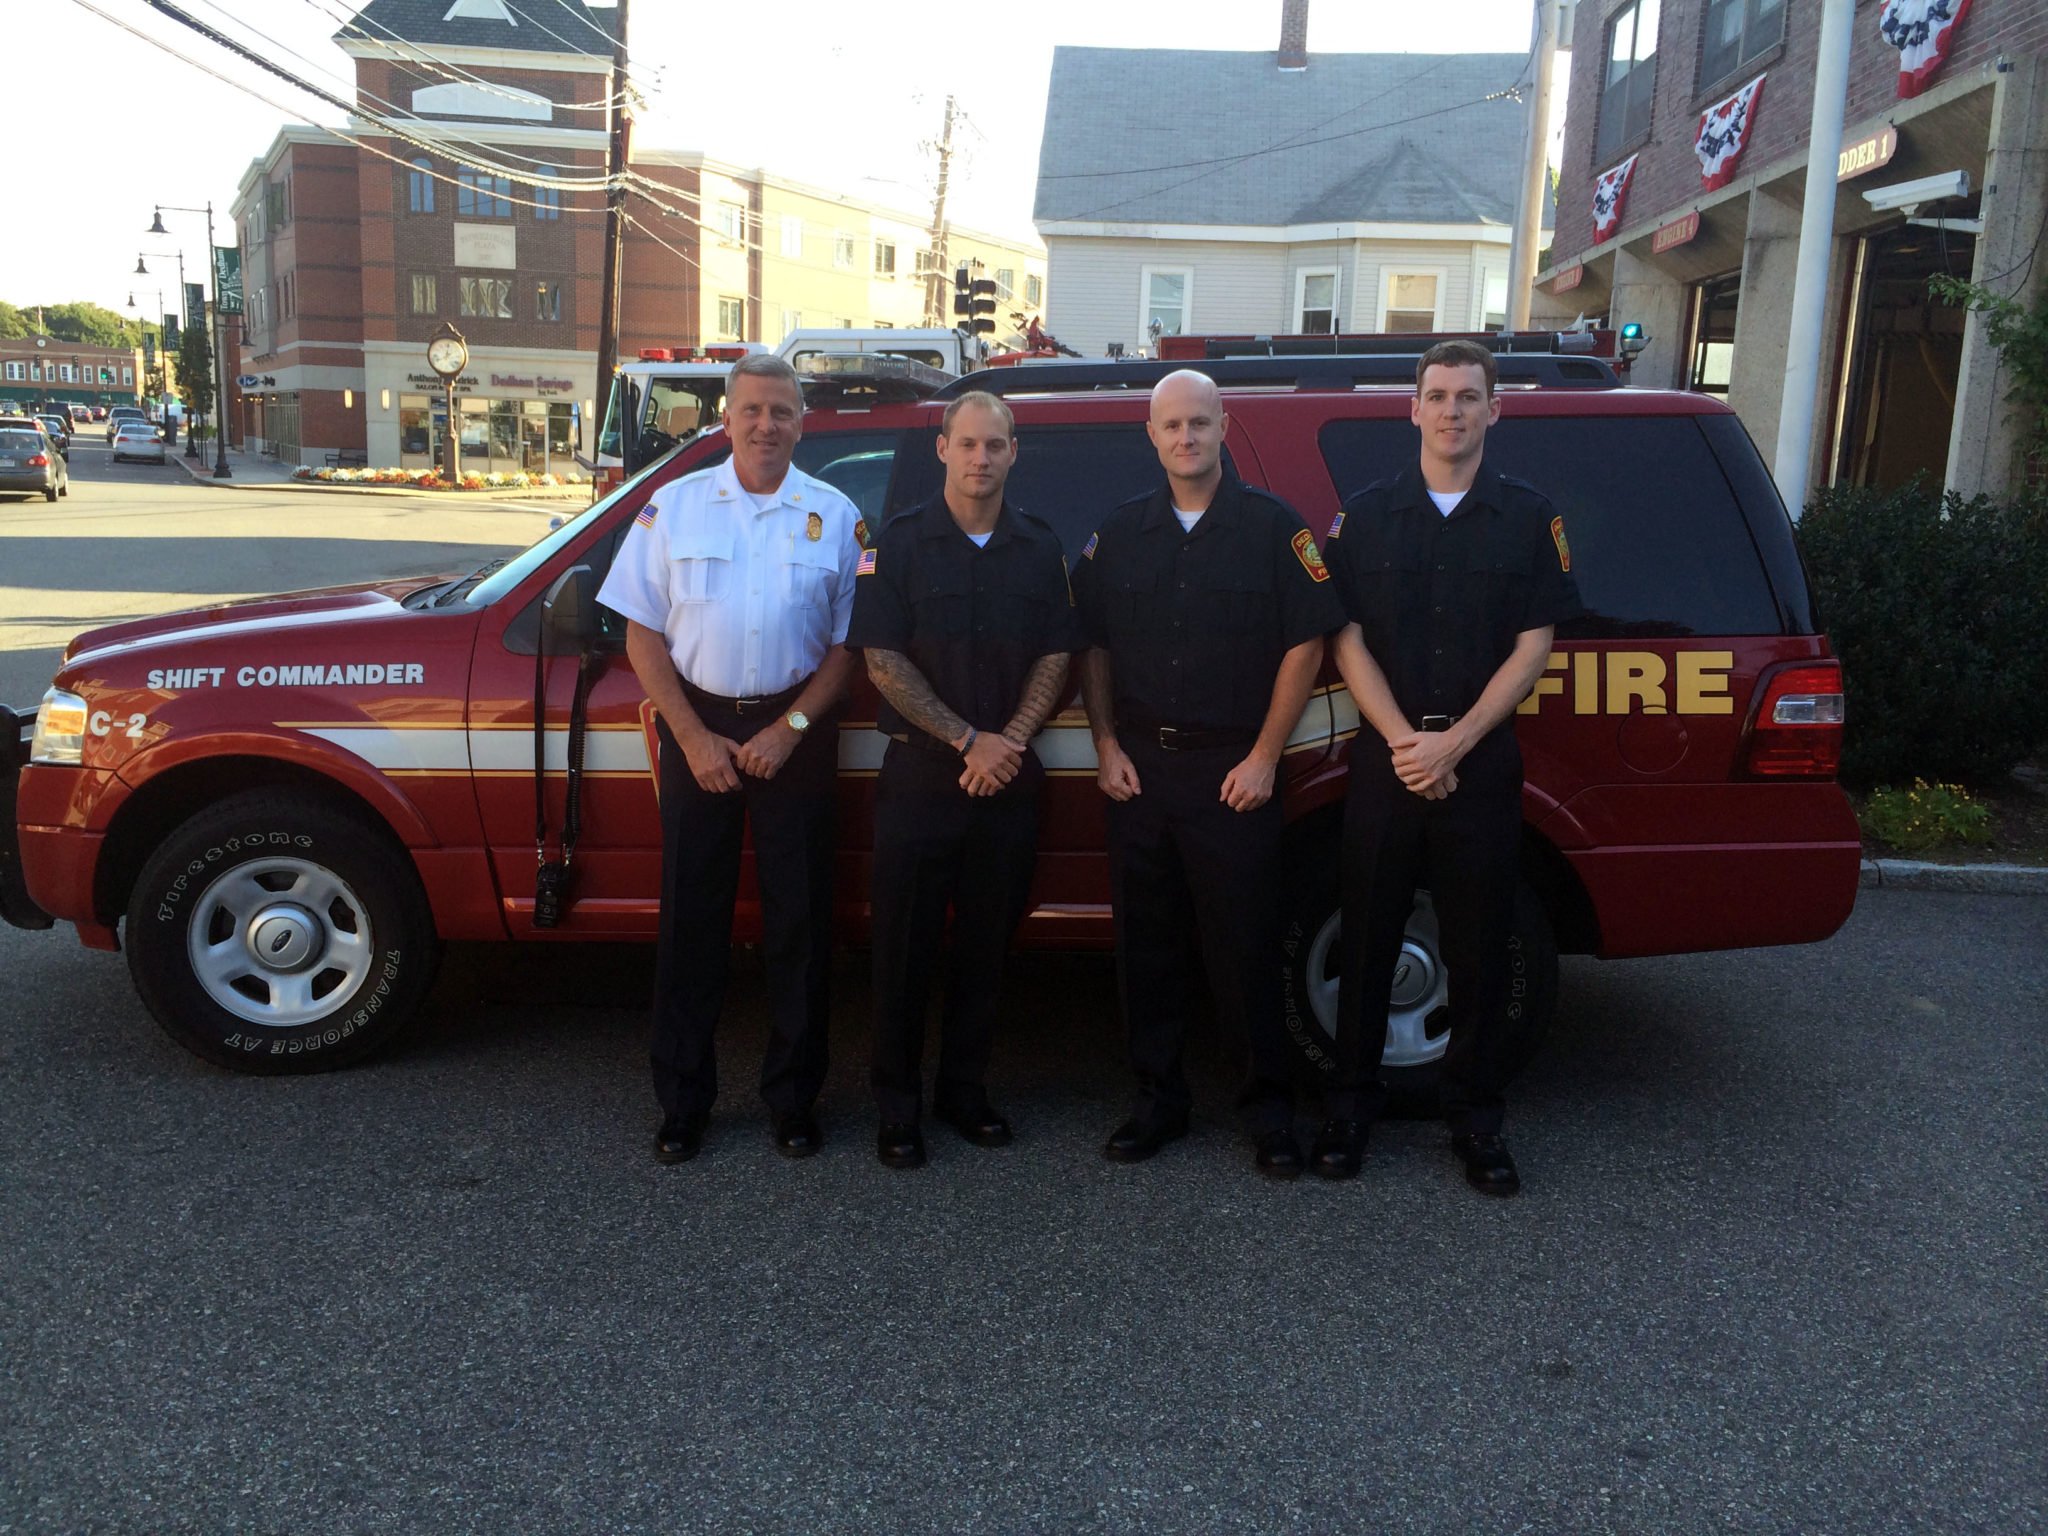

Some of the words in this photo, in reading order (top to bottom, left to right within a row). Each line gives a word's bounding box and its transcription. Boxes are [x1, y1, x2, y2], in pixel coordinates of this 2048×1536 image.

[1837, 139, 1877, 177] DDER
[1880, 133, 1889, 160] 1
[1656, 220, 1687, 249] ENGINE
[407, 373, 442, 386] Anthony
[491, 374, 534, 388] Dedham
[536, 376, 574, 391] Savings
[856, 522, 866, 534] DED
[1296, 533, 1312, 547] DED
[147, 667, 225, 690] SHIFT
[236, 663, 425, 688] COMMANDER
[1516, 651, 1734, 715] FIRE
[90, 710, 147, 738] C-2
[158, 832, 313, 921] Firestone
[271, 950, 400, 1054] TRANSFORCE
[224, 1032, 263, 1051] AT
